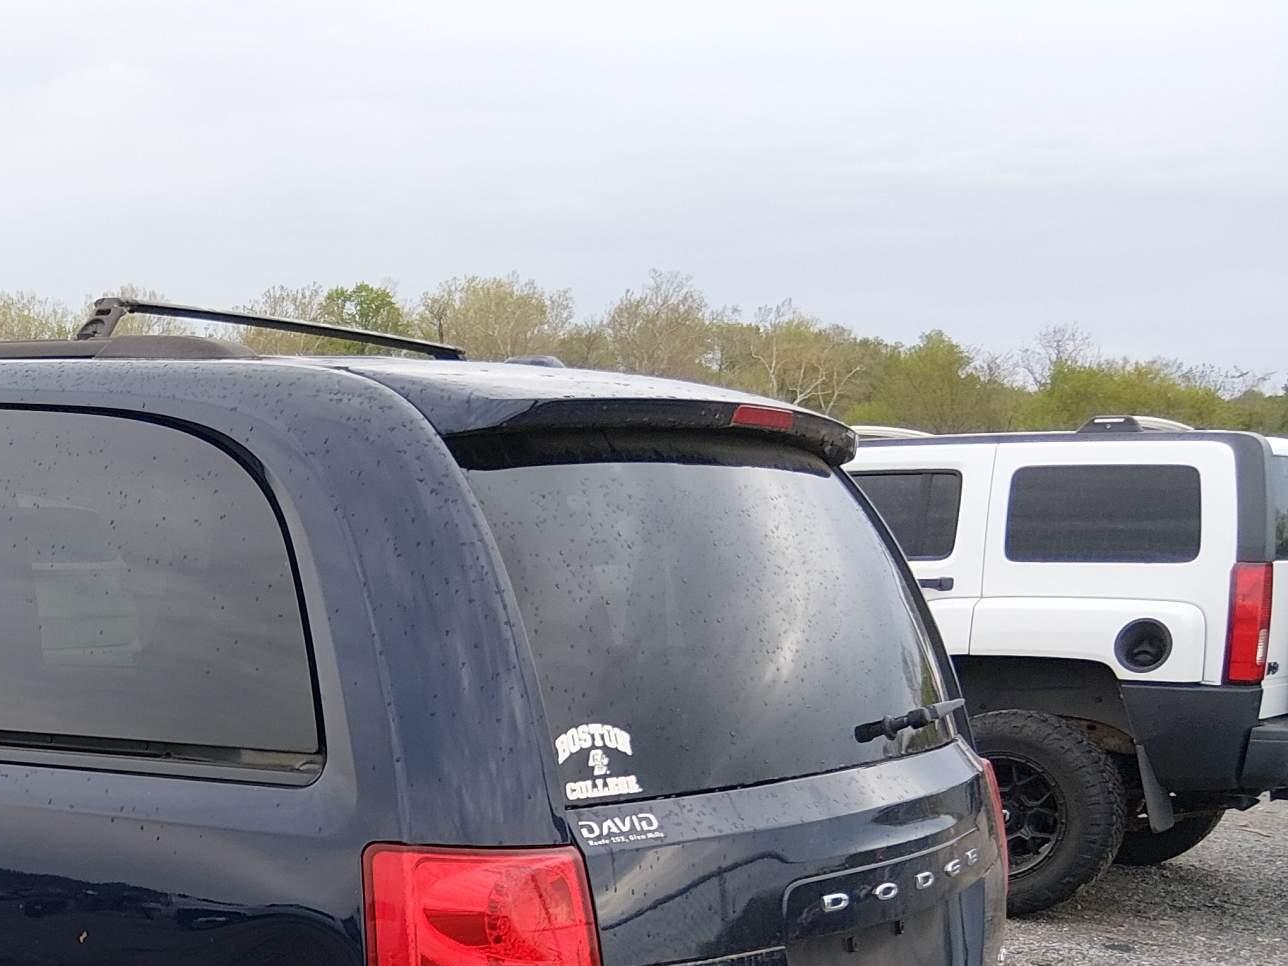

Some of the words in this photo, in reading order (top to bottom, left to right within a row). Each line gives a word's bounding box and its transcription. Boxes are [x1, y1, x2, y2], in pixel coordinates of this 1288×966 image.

[555, 723, 633, 766] BOSTON
[578, 813, 659, 839] DAVID
[822, 848, 979, 912] DODGE
